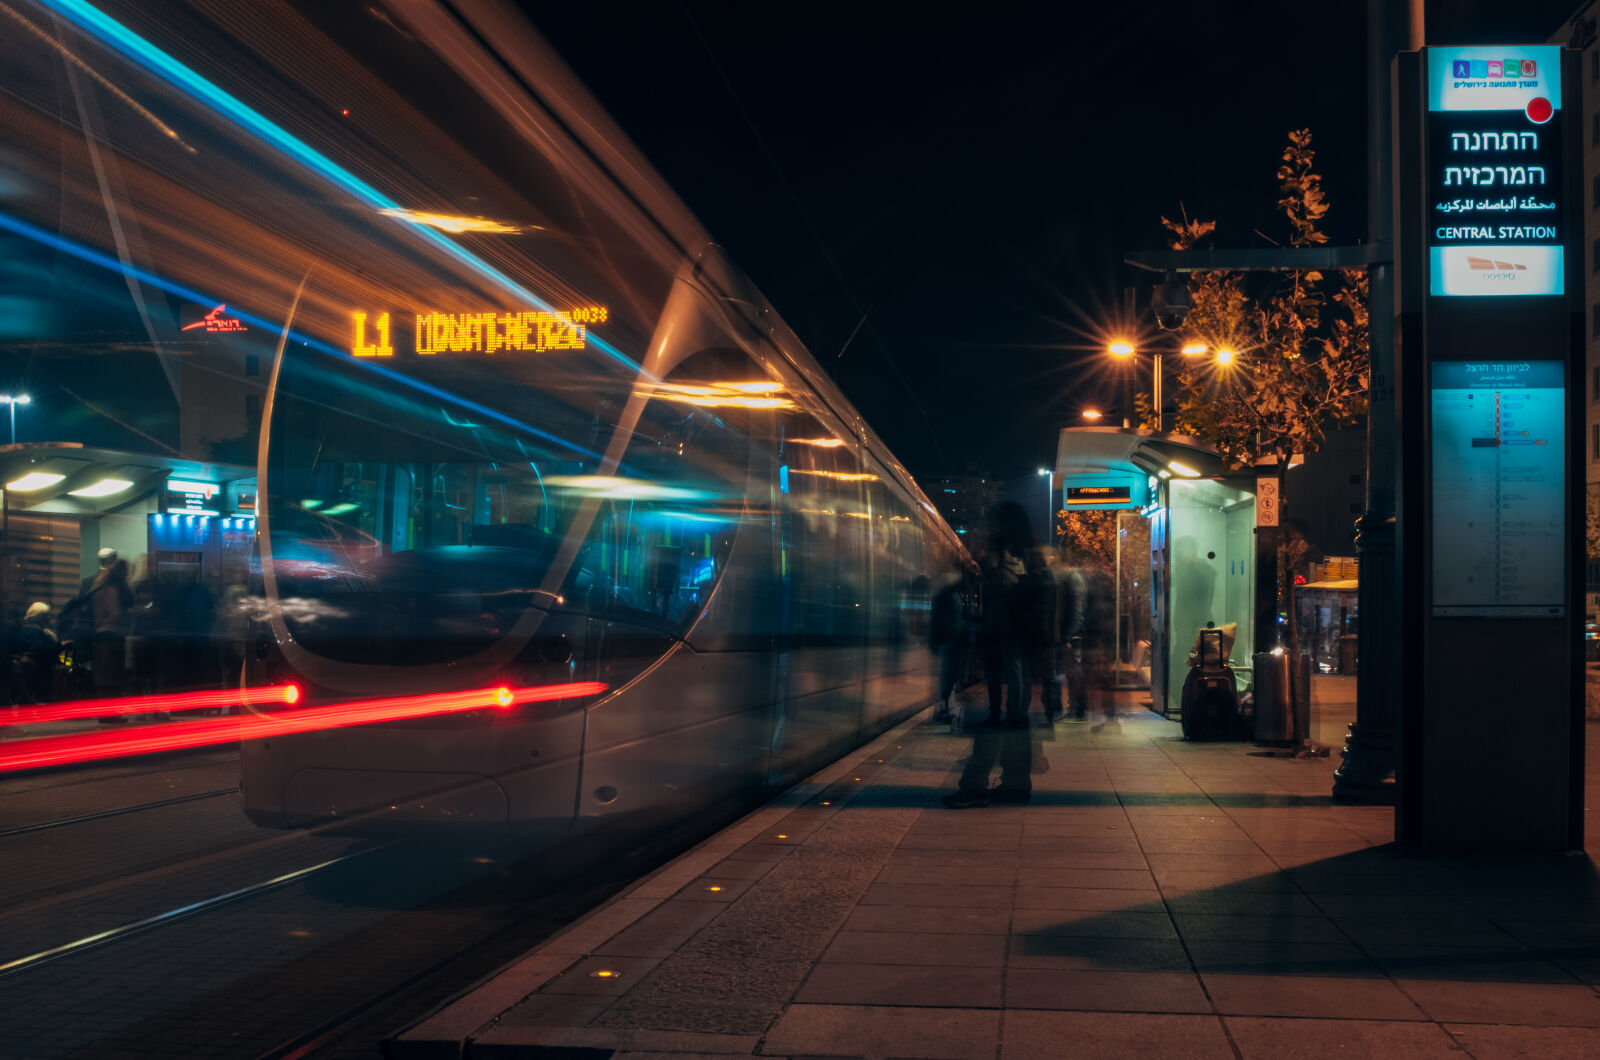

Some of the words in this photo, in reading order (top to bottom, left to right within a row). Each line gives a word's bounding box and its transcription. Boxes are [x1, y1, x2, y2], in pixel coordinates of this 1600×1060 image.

[1451, 132, 1538, 151] התחנה
[1443, 166, 1545, 185] המרכזית
[1436, 226, 1496, 239] CENTRAL
[1498, 226, 1556, 238] STATION
[353, 312, 393, 357] L1
